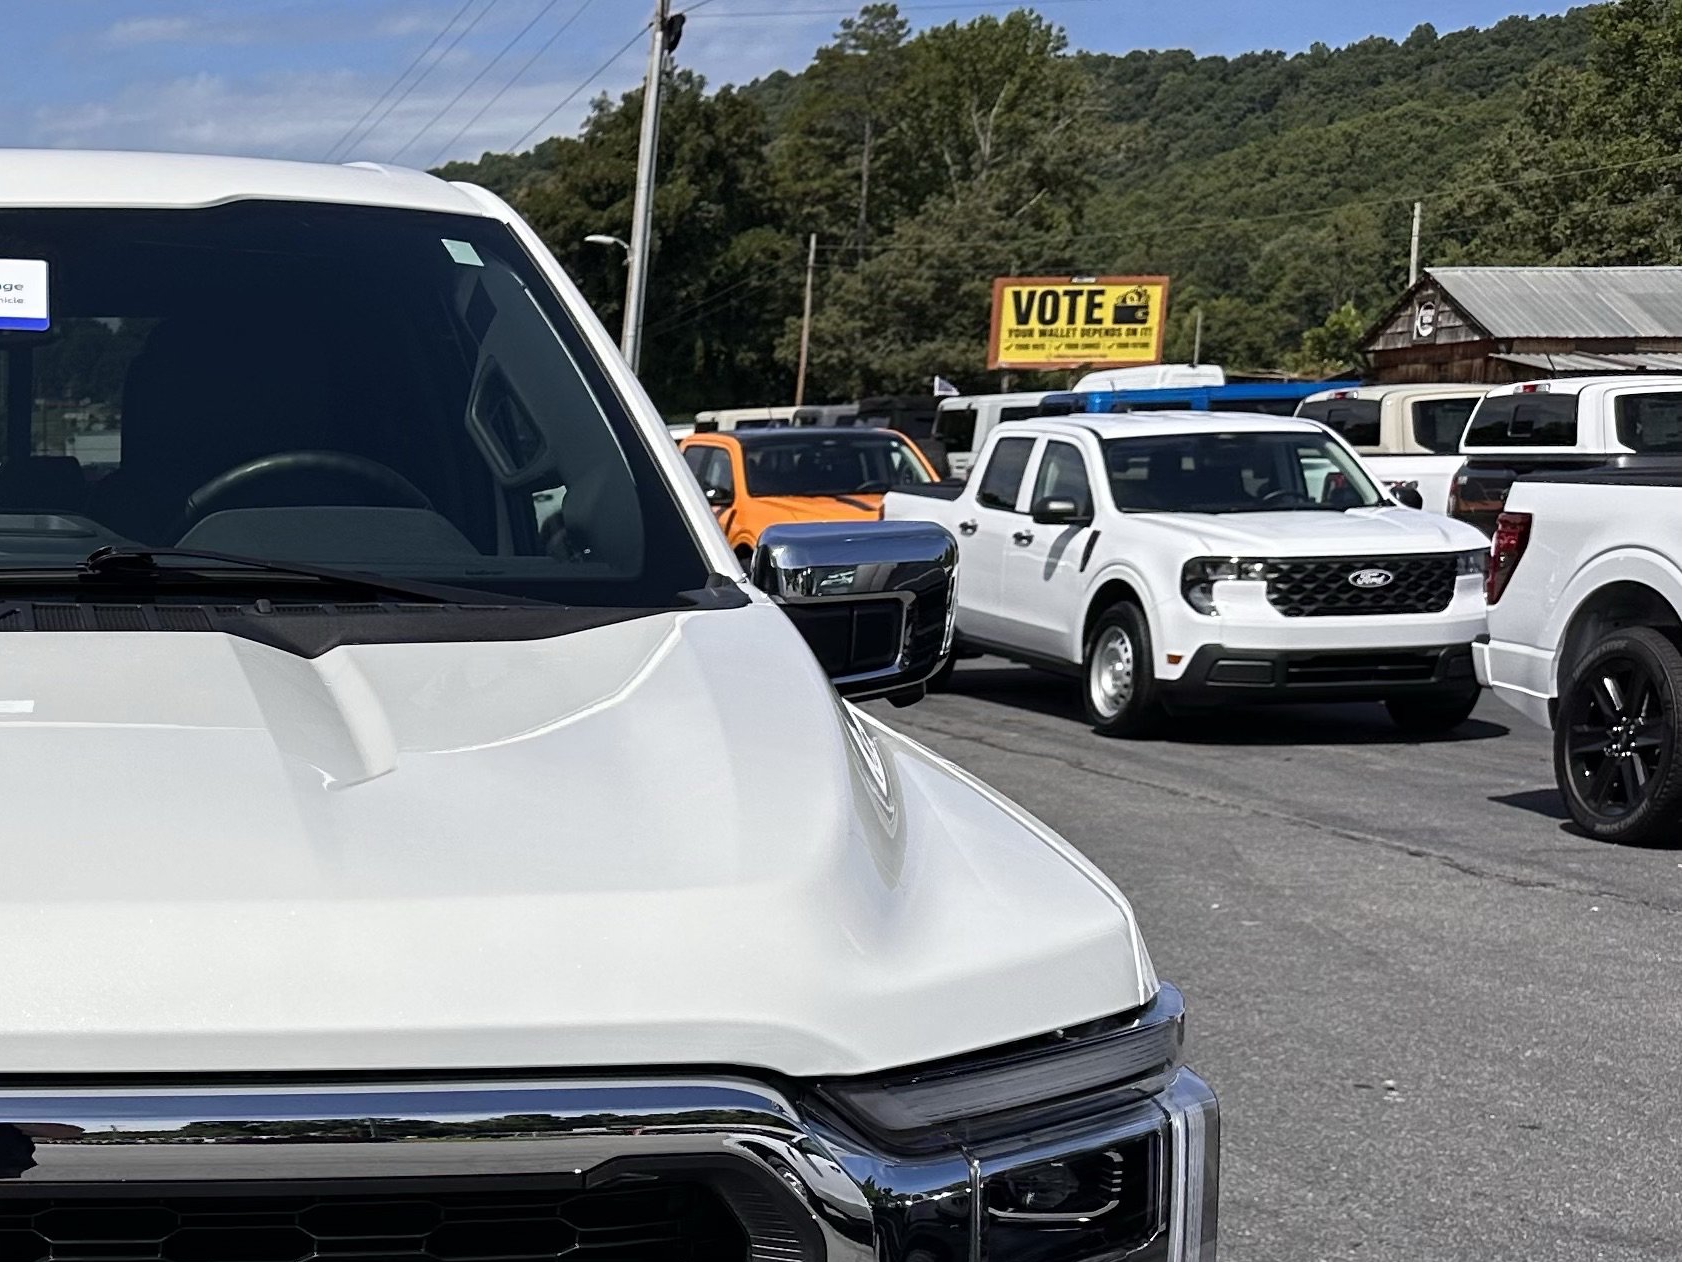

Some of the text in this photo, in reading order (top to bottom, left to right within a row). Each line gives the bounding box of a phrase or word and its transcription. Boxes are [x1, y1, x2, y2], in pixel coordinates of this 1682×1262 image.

[1012, 289, 1105, 325] VOTE
[1038, 327, 1077, 338] WALLET
[1080, 327, 1122, 338] DEPENDS
